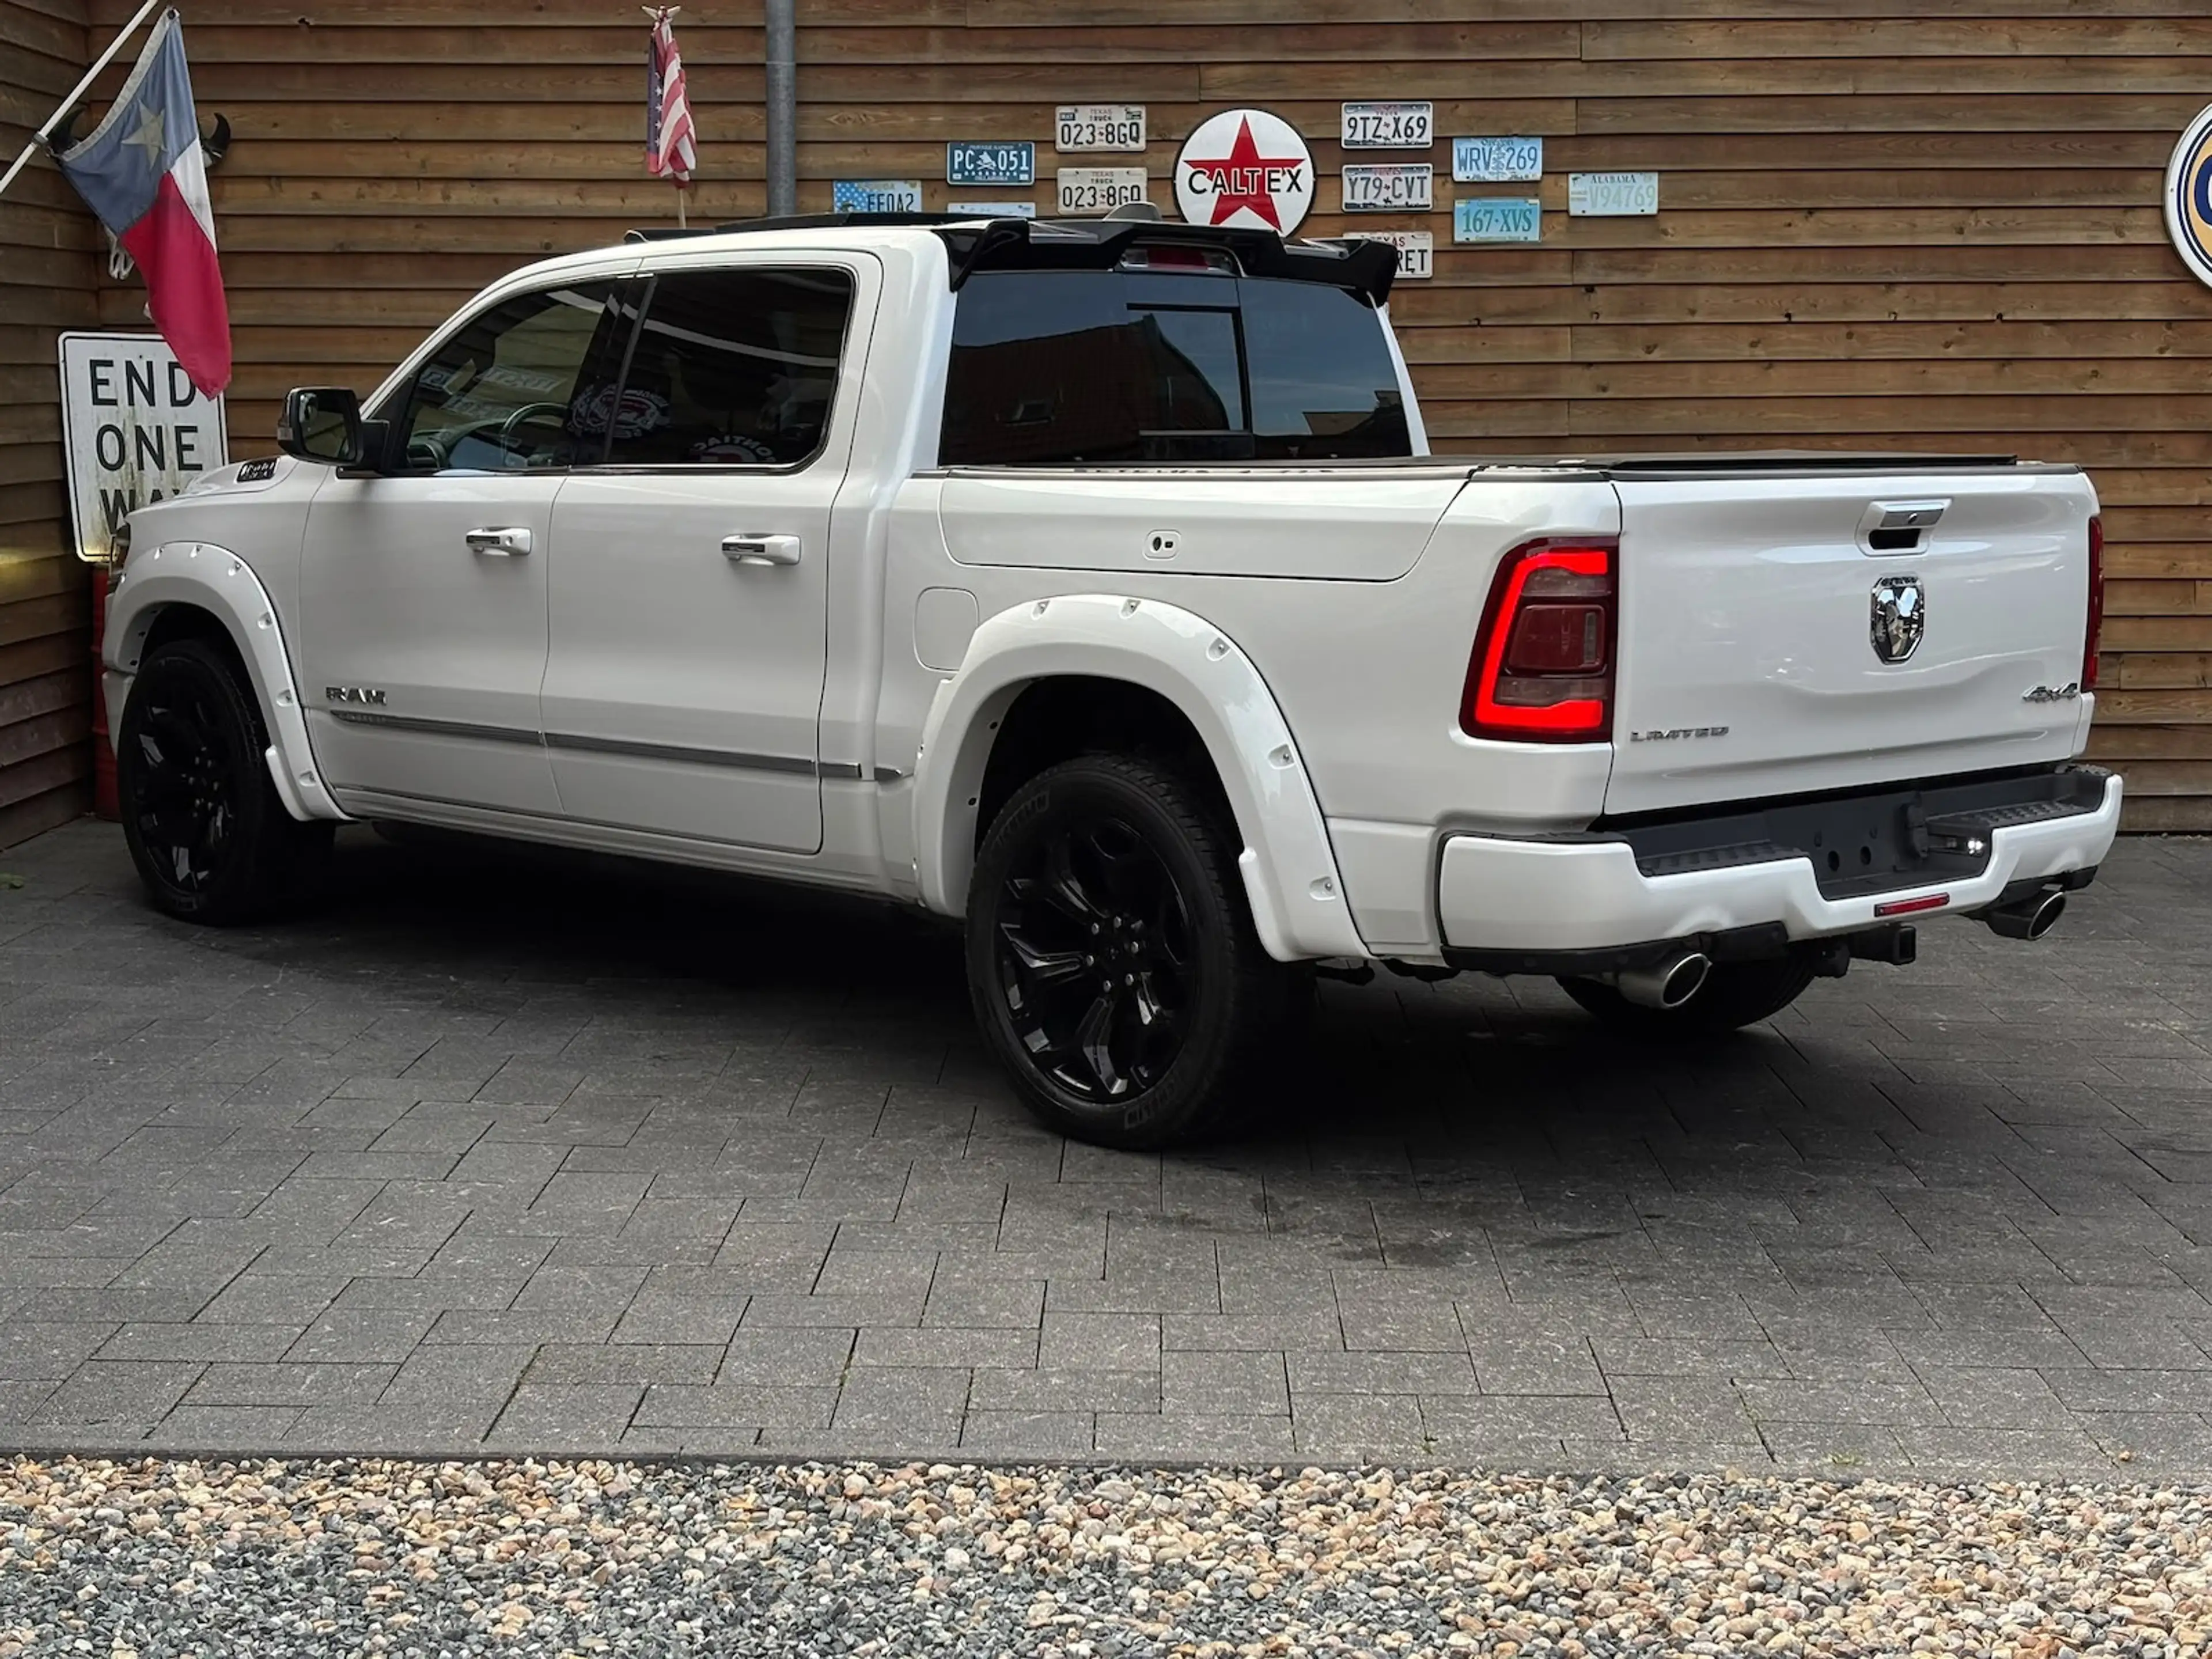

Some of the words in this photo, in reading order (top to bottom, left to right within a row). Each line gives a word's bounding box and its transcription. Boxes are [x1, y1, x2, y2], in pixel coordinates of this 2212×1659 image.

[1188, 169, 1303, 195] CALTEX
[1590, 174, 1637, 184] ALABAMA
[89, 359, 197, 407] END
[96, 424, 203, 471] ONE
[325, 687, 387, 706] RAM
[1630, 726, 1730, 742] LIMITED
